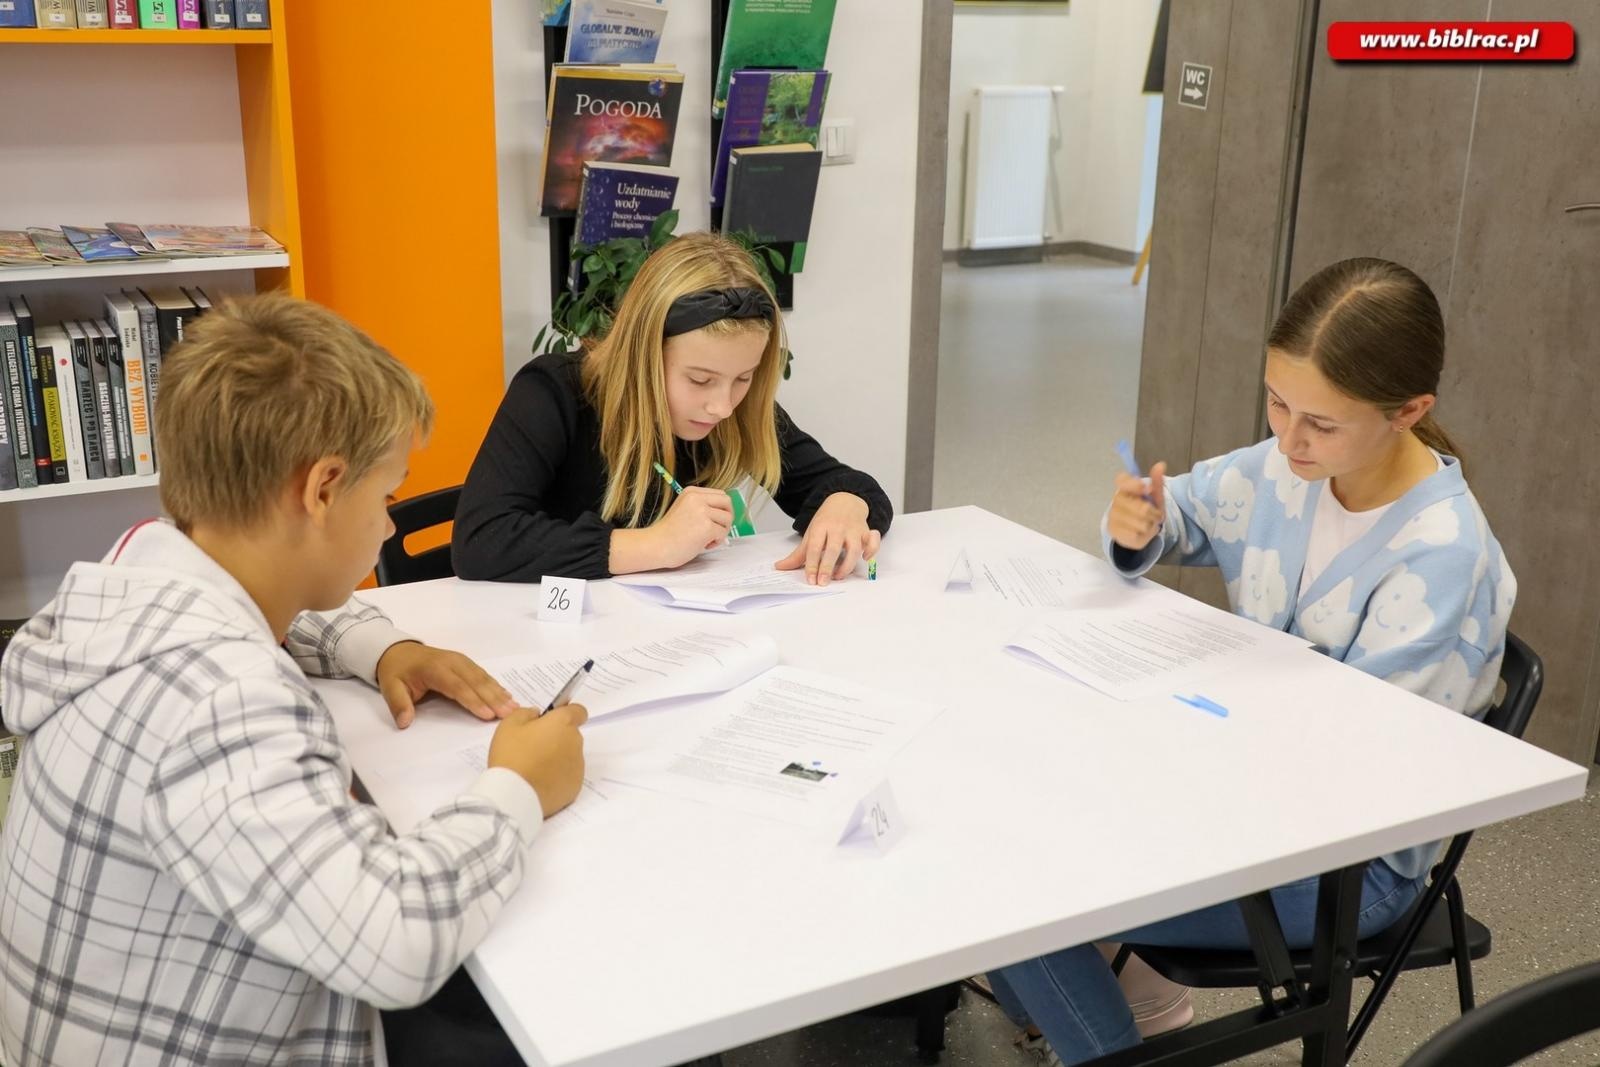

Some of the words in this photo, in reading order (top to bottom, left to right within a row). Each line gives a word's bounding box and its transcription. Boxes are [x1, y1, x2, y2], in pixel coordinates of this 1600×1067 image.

[580, 23, 622, 35] GLOBALNE
[624, 25, 655, 39] ZMIANY
[1186, 68, 1205, 86] WC
[574, 93, 662, 119] POGODA
[617, 182, 672, 200] Uzdatnianie
[615, 198, 640, 211] wody
[5, 341, 20, 386] INTELIGENTNA
[127, 360, 143, 383] BEZ
[12, 386, 23, 409] FORMA
[80, 380, 95, 414] MARZEC
[88, 433, 100, 462] MARCU
[129, 386, 148, 435] WYBORU
[14, 408, 29, 456] INTERNOWANIA
[547, 586, 570, 610] 26
